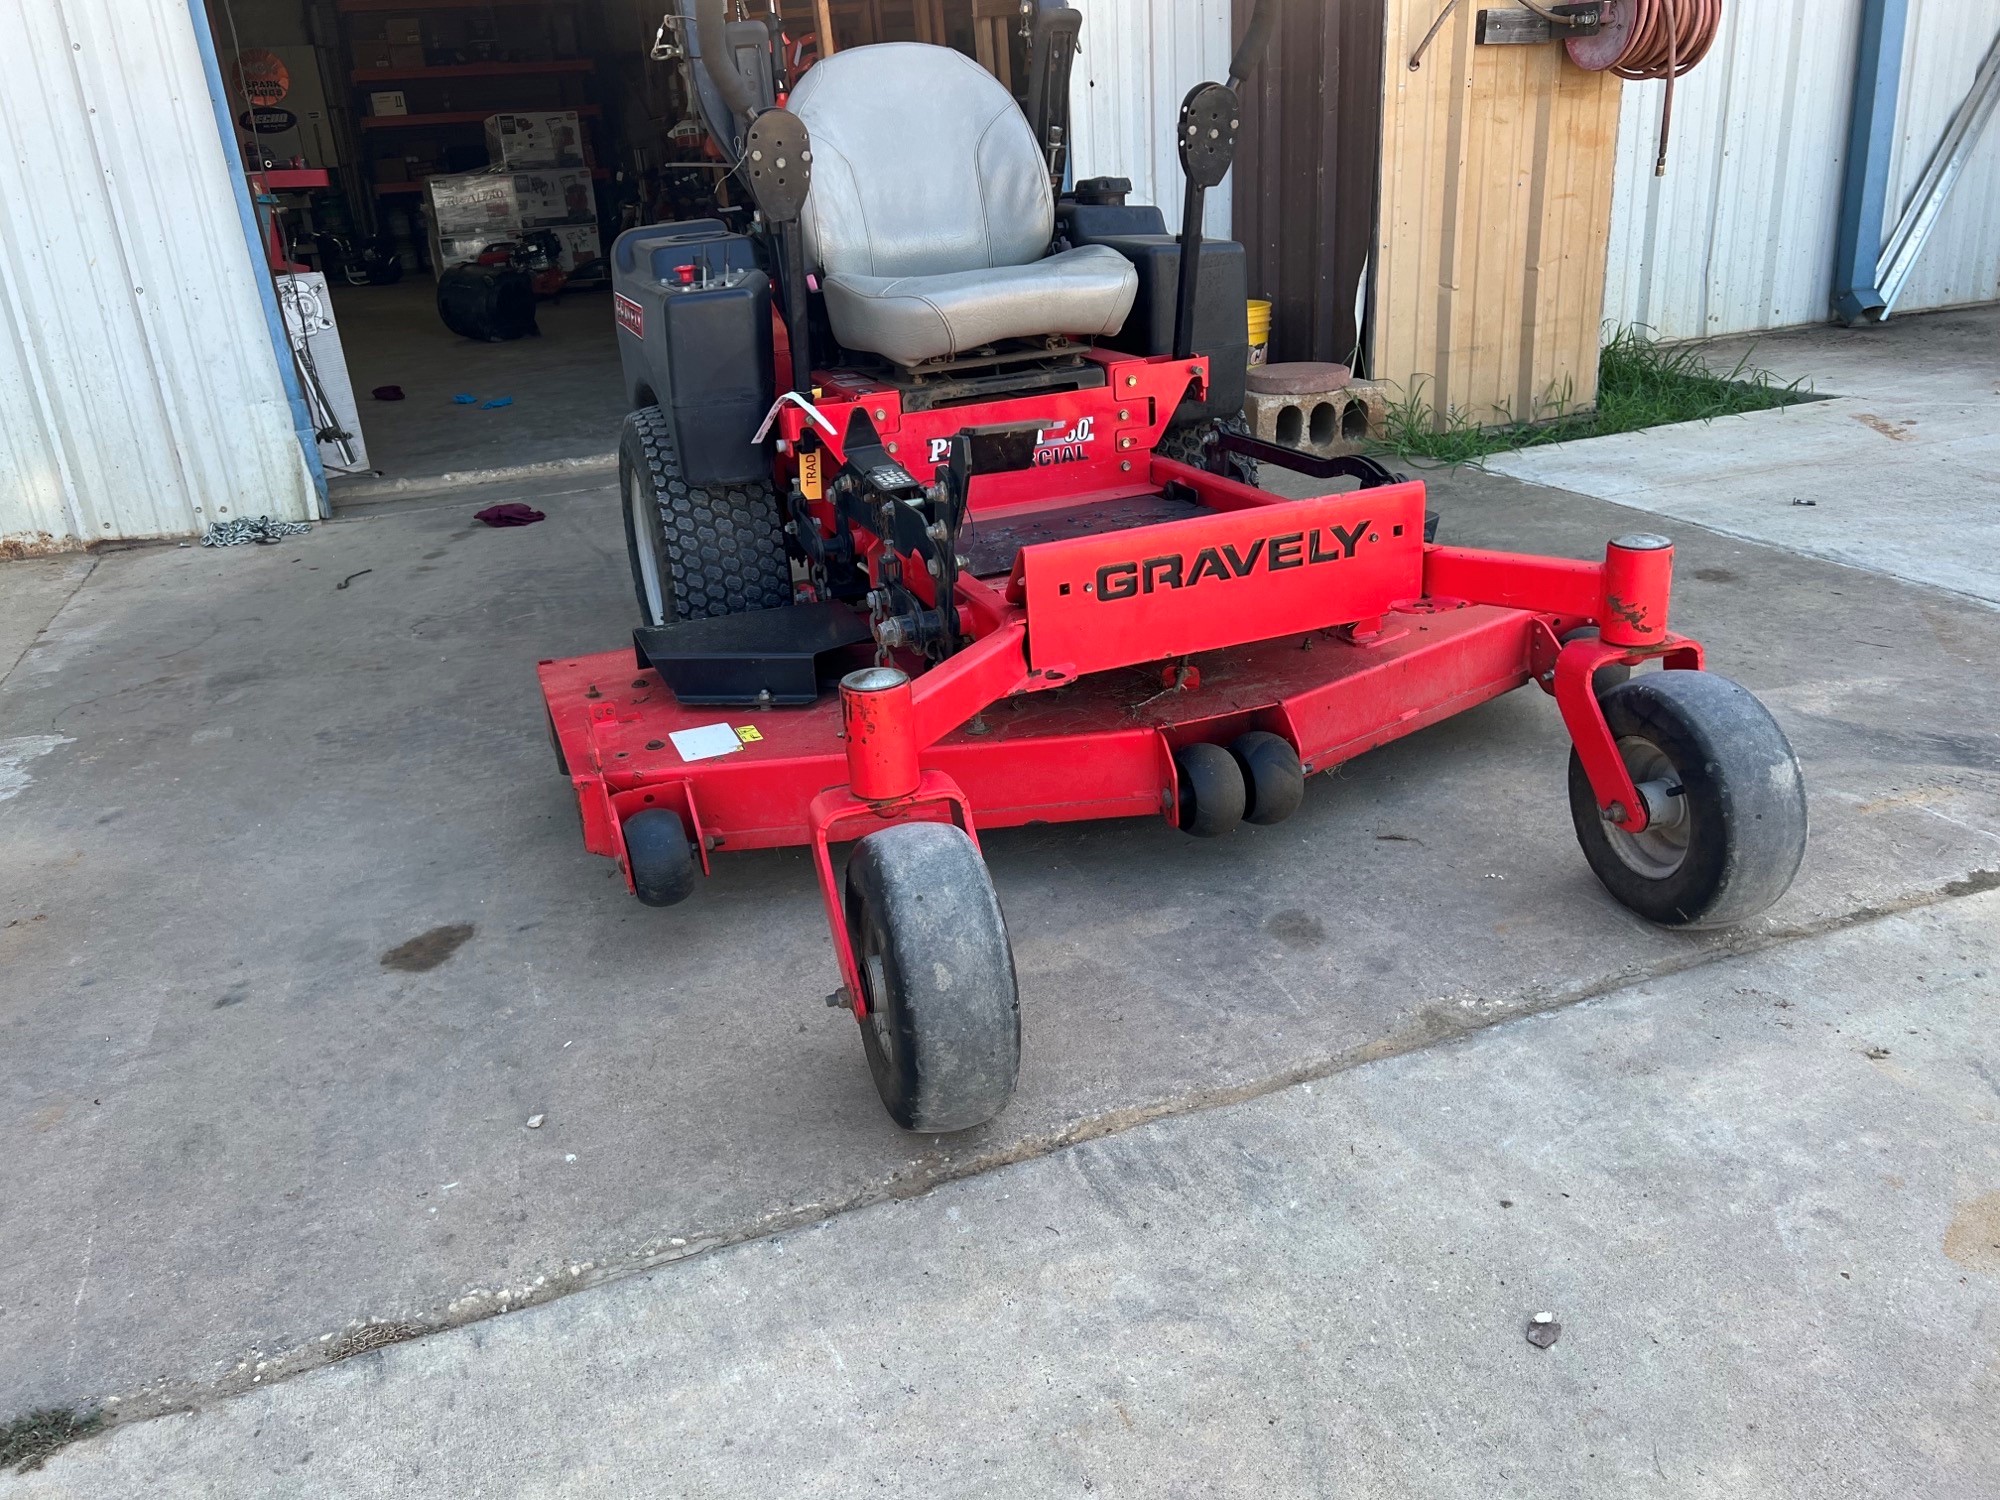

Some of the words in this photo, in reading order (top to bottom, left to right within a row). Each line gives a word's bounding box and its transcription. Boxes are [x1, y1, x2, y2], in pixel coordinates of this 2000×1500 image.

[245, 80, 281, 88] SPARK
[247, 89, 283, 97] PLUGS
[1096, 520, 1372, 602] GRAVELY
